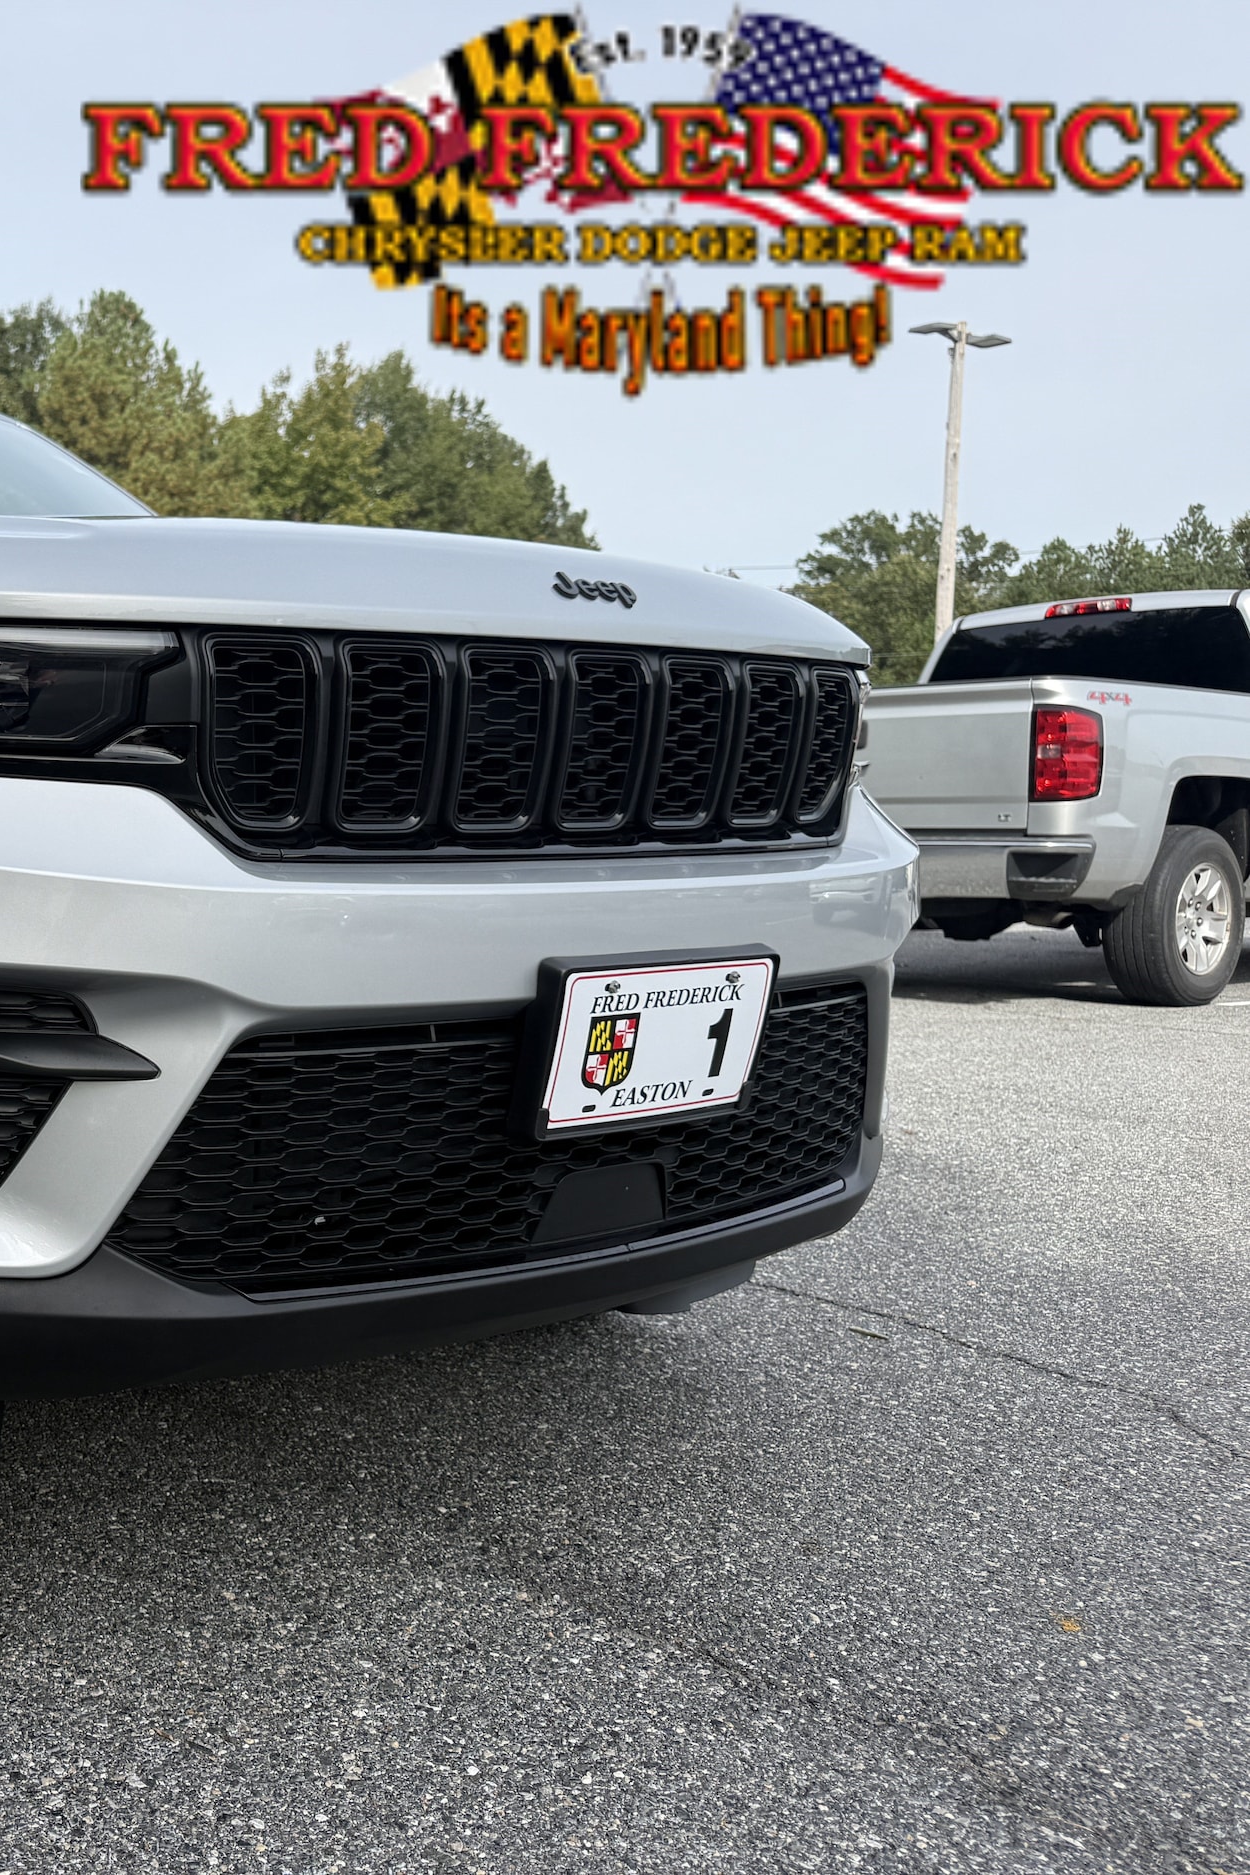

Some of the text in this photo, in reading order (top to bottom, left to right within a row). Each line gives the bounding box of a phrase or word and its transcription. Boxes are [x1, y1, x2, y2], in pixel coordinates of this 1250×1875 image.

[552, 571, 637, 609] Jeep
[590, 984, 745, 1014] FRED FREDERICK
[707, 1008, 733, 1078] 1
[610, 1080, 693, 1108] EASTON
